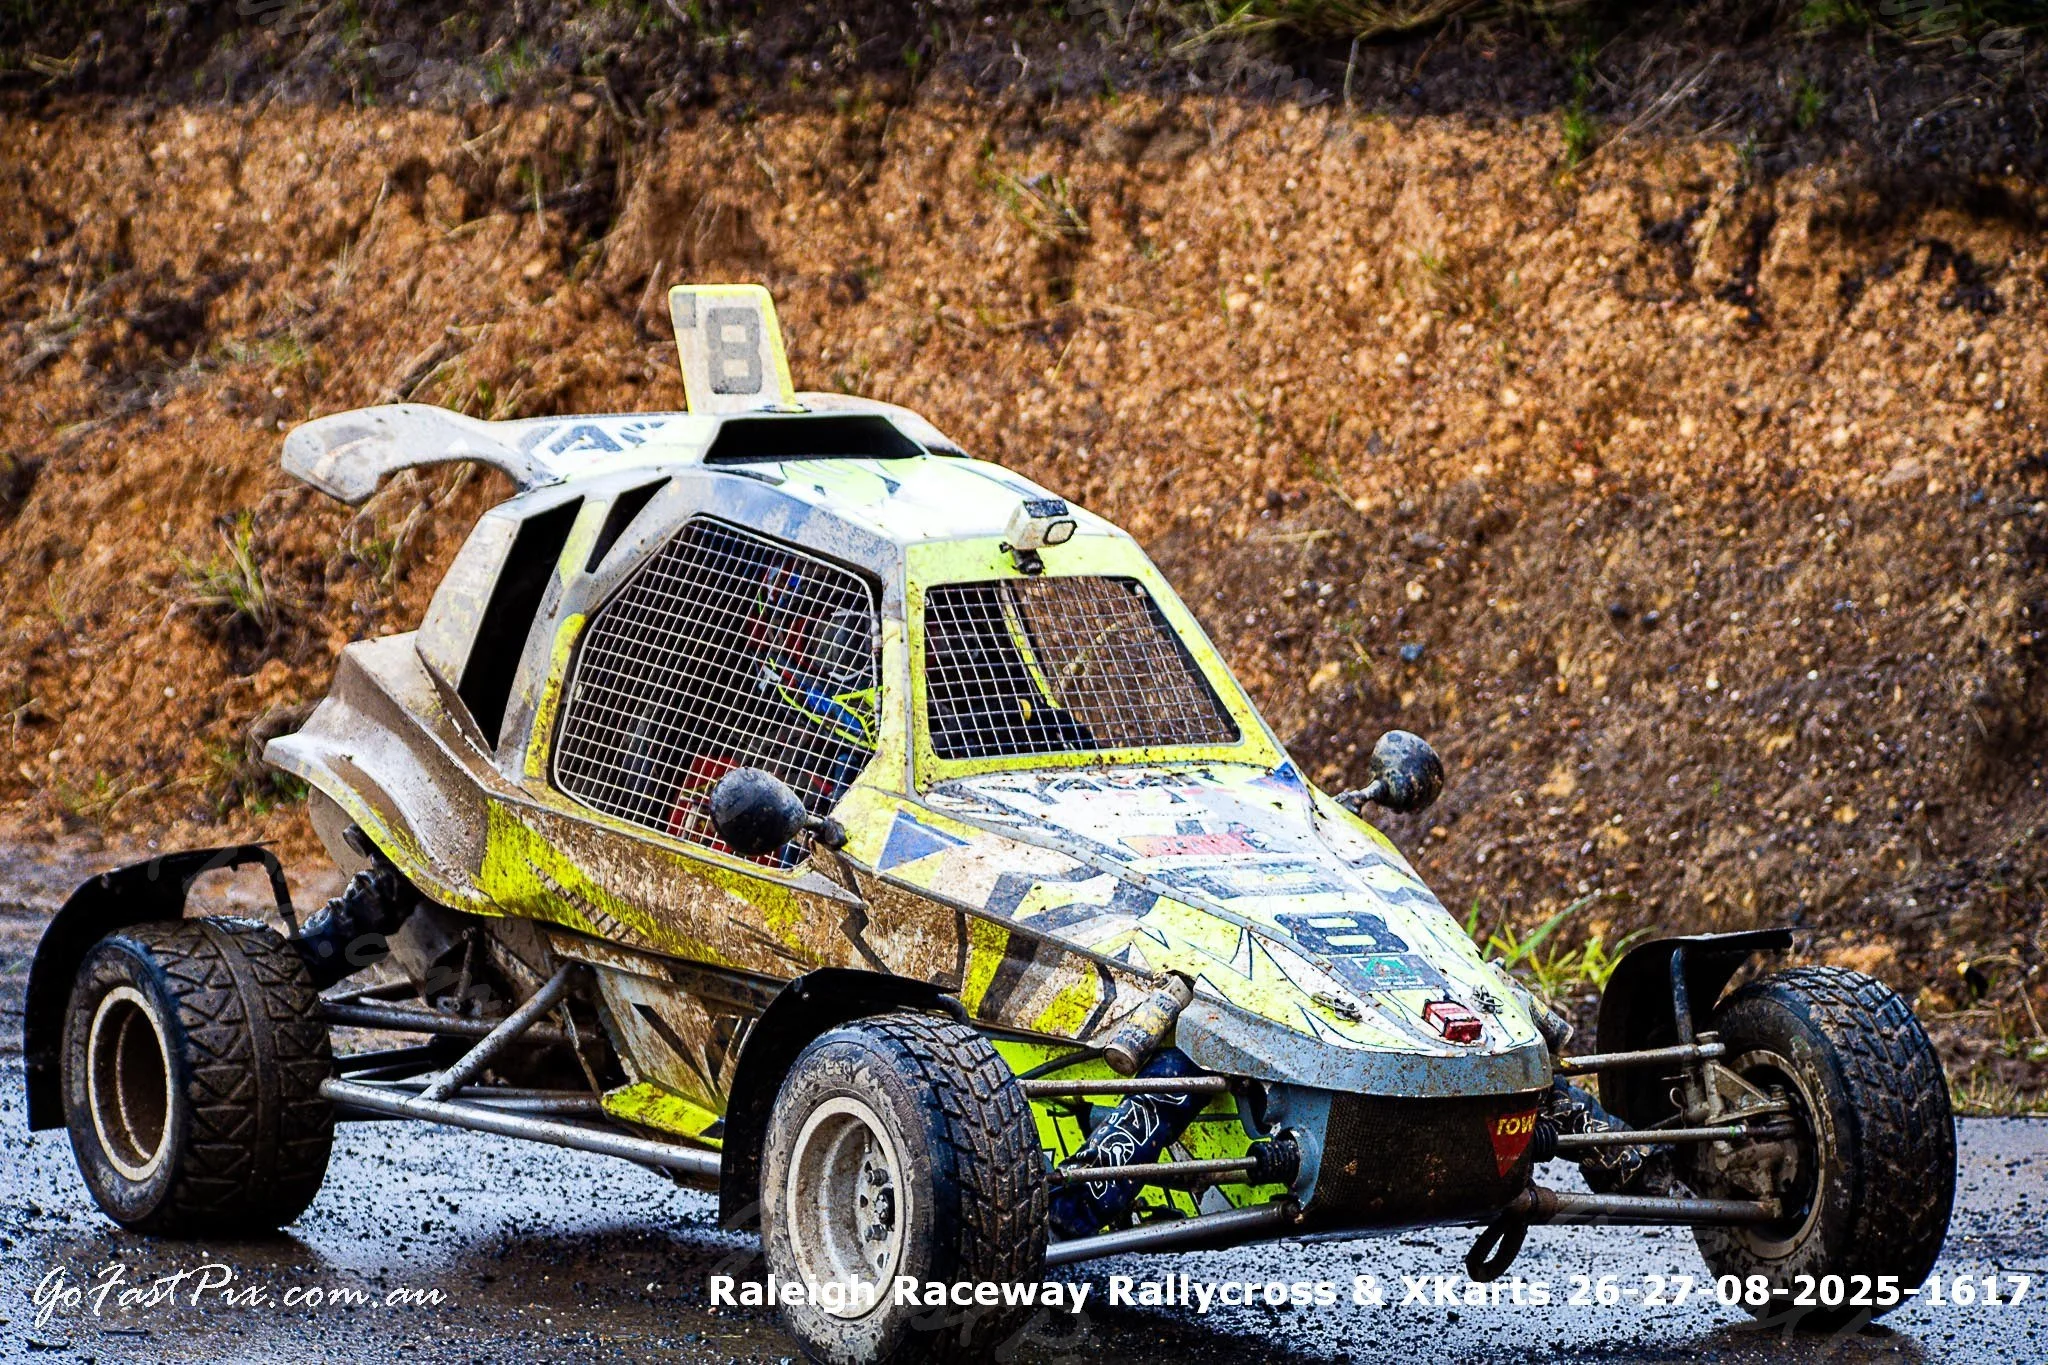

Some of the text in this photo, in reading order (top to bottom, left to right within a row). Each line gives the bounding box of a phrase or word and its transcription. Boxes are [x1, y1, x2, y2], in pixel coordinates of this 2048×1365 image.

[706, 307, 763, 395] 8
[1274, 911, 1409, 955] 8
[1496, 1113, 1537, 1136] TOW
